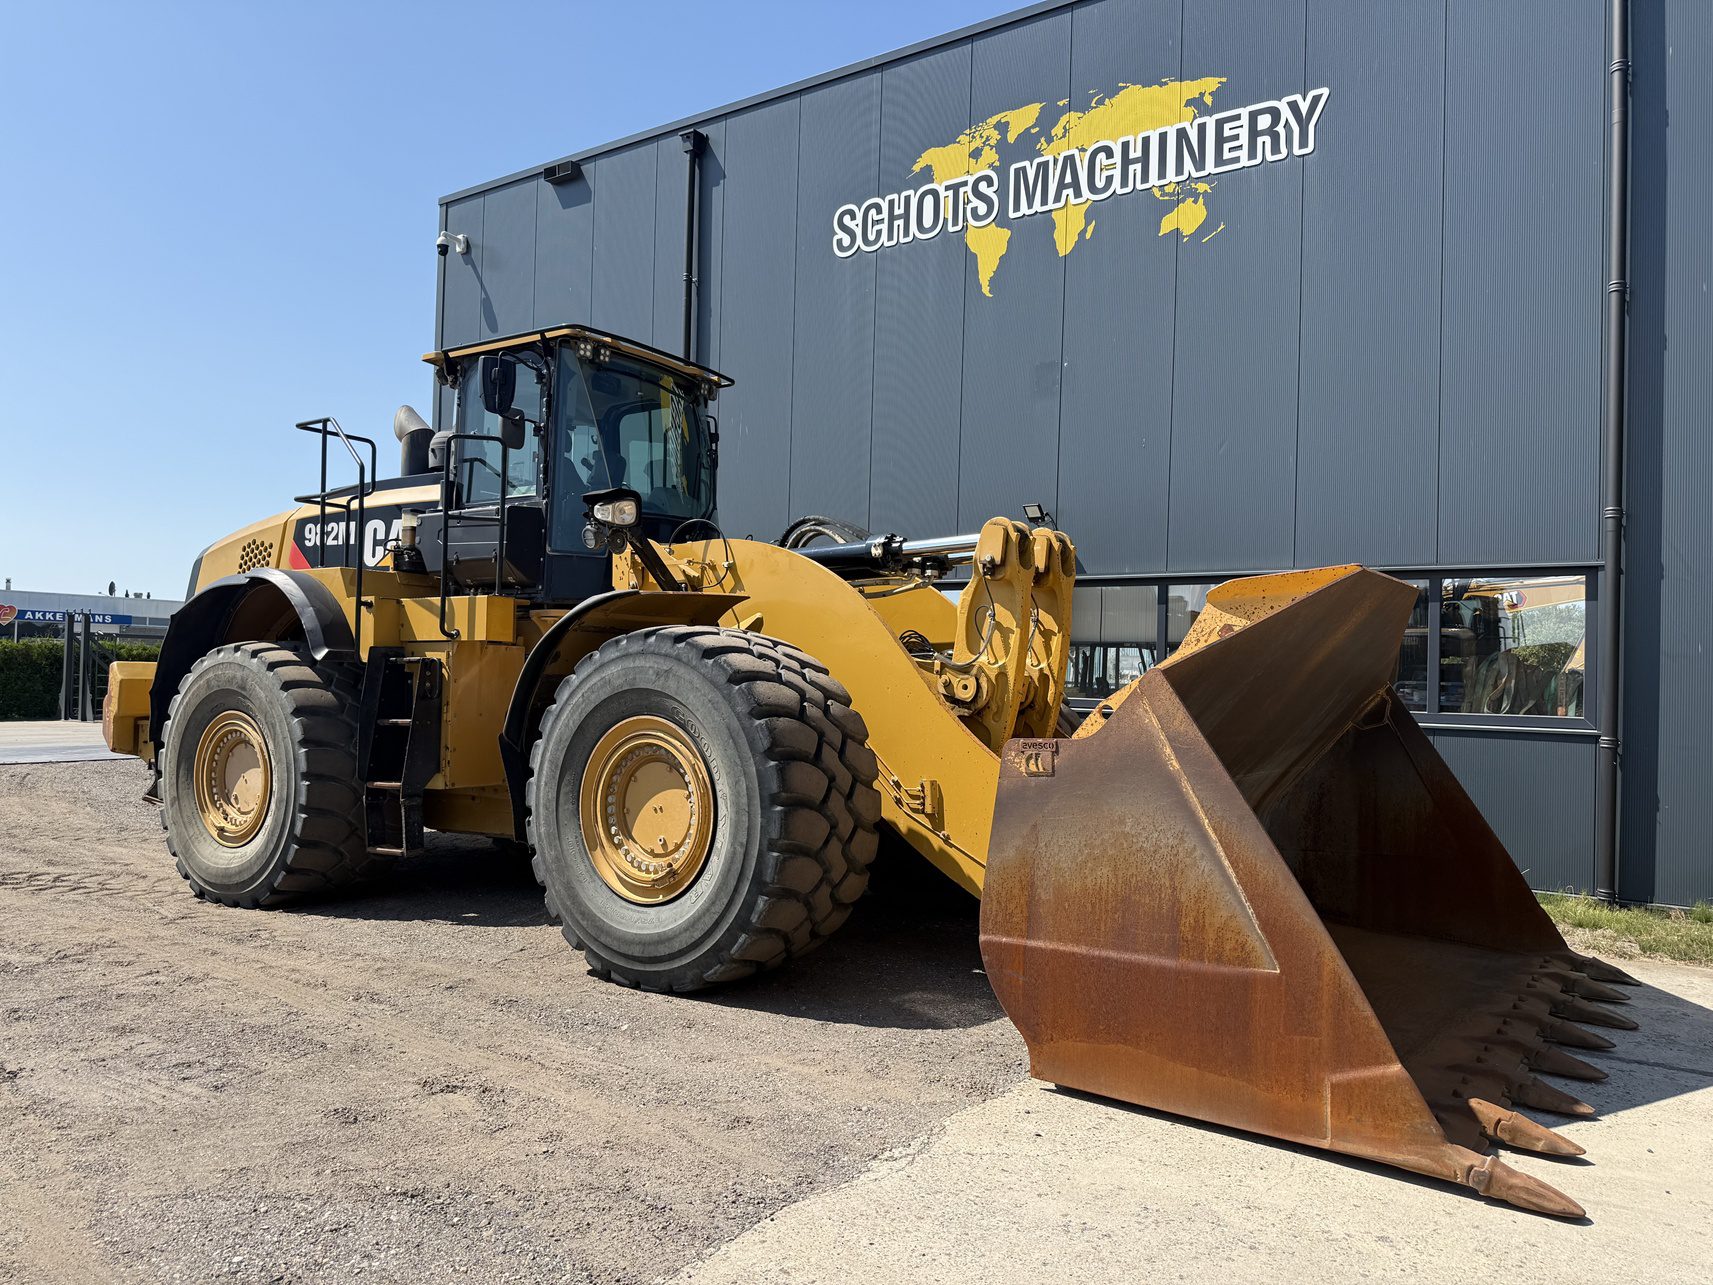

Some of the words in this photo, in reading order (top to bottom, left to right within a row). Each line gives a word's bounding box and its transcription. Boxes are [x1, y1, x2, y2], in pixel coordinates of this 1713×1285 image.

[833, 169, 999, 258] SCHOTS
[1008, 87, 1330, 219] MACHINERY
[25, 611, 112, 623] AKKEMNS
